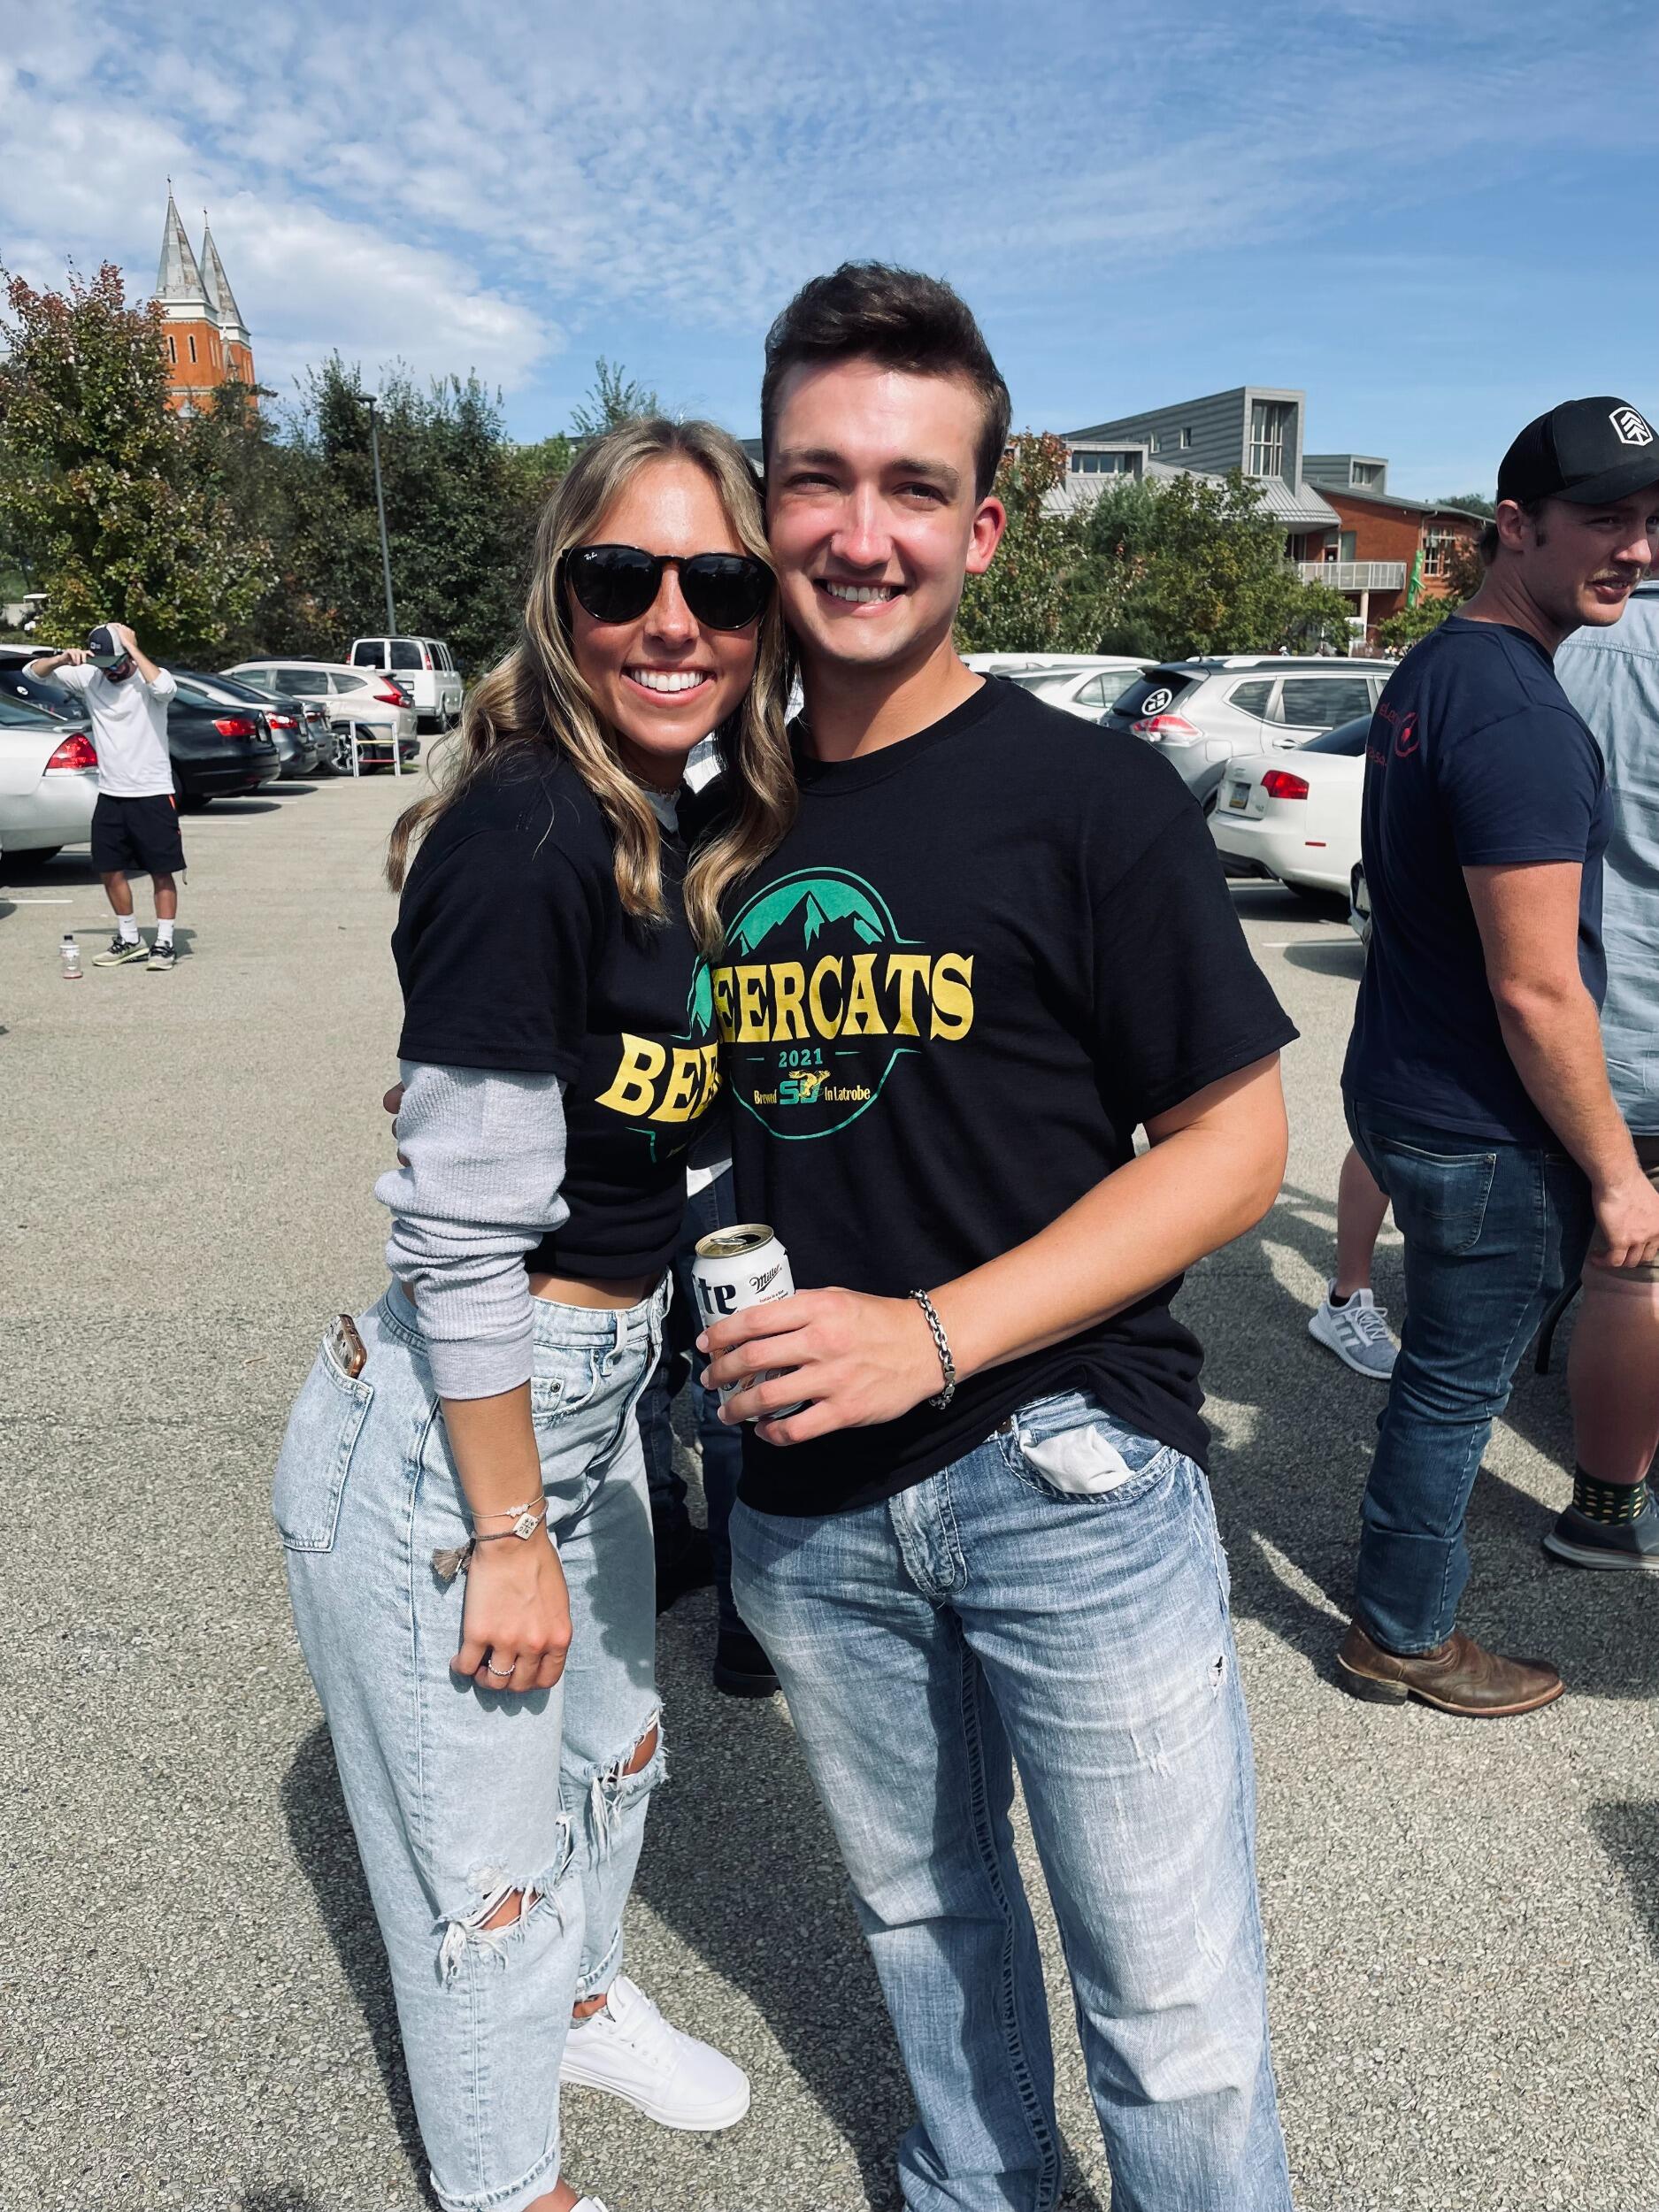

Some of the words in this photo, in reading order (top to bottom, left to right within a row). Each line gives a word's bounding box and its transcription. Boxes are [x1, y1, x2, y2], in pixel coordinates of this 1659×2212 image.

[779, 1048, 823, 1068] 2021
[754, 1089, 777, 1104] Brewed
[825, 1087, 833, 1102] In
[833, 1085, 871, 1102] Latrobe
[749, 1264, 780, 1293] Miller
